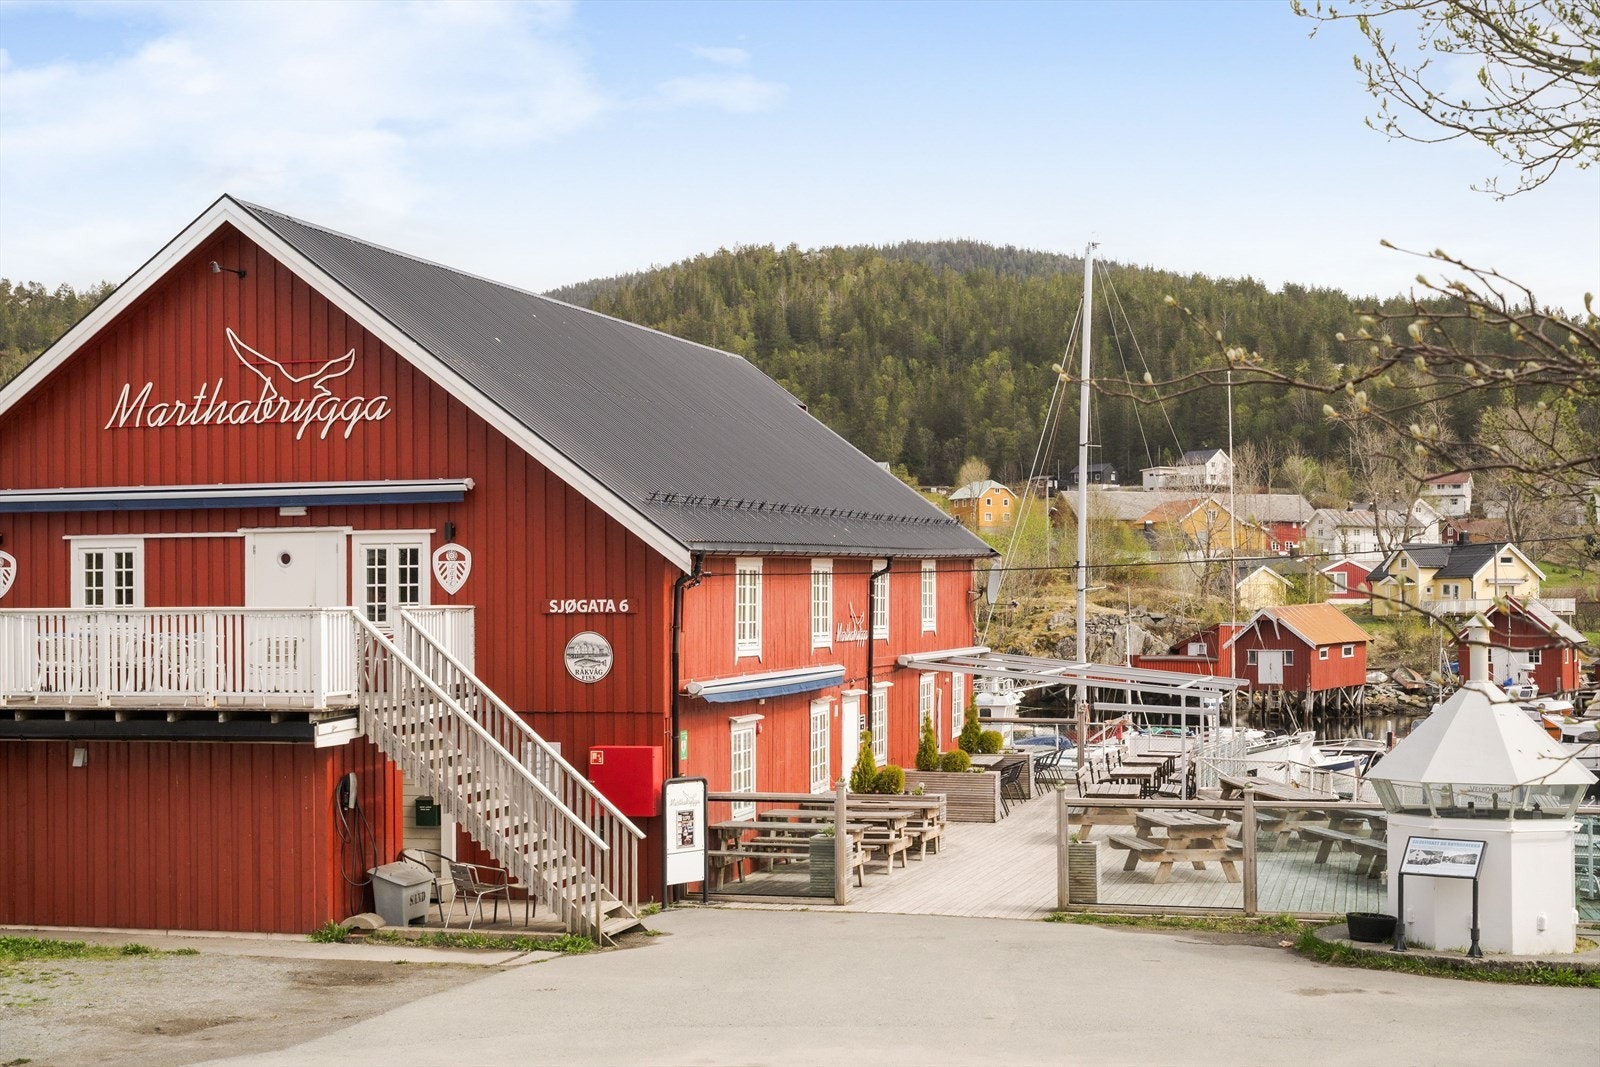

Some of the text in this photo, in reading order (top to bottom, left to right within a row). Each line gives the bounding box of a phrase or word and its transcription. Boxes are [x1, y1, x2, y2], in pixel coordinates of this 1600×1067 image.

[104, 376, 392, 440] Marthabrygga
[549, 599, 629, 614] SJØGATA 6
